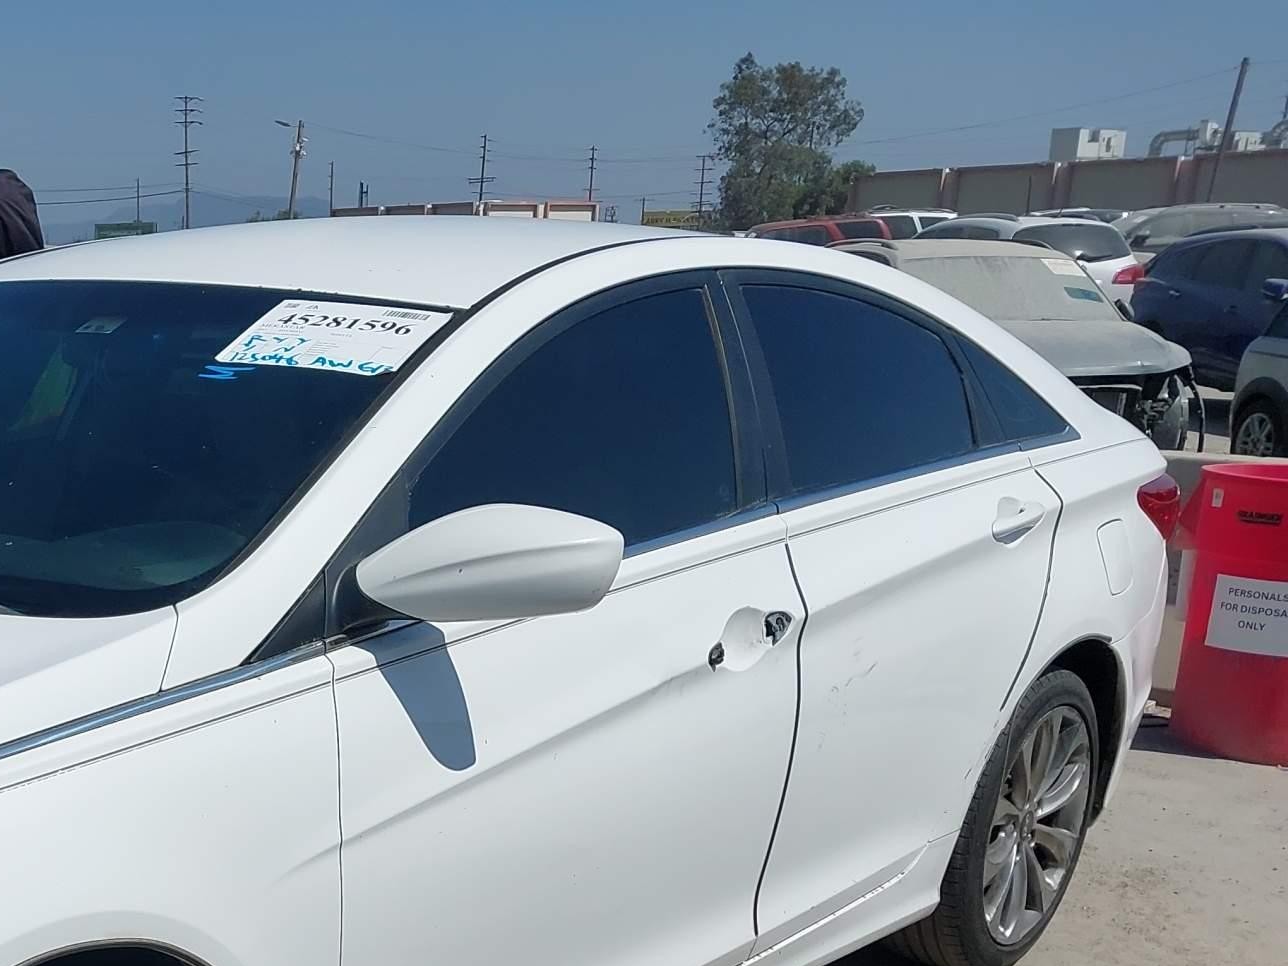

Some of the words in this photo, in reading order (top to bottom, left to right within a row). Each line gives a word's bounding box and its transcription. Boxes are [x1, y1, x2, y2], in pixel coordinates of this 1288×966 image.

[278, 313, 416, 335] 45281596
[1228, 587, 1288, 602] PERSONALS
[1220, 601, 1239, 612] FOR
[1240, 604, 1288, 617] DISPOSA
[1238, 620, 1266, 631] ONLY
